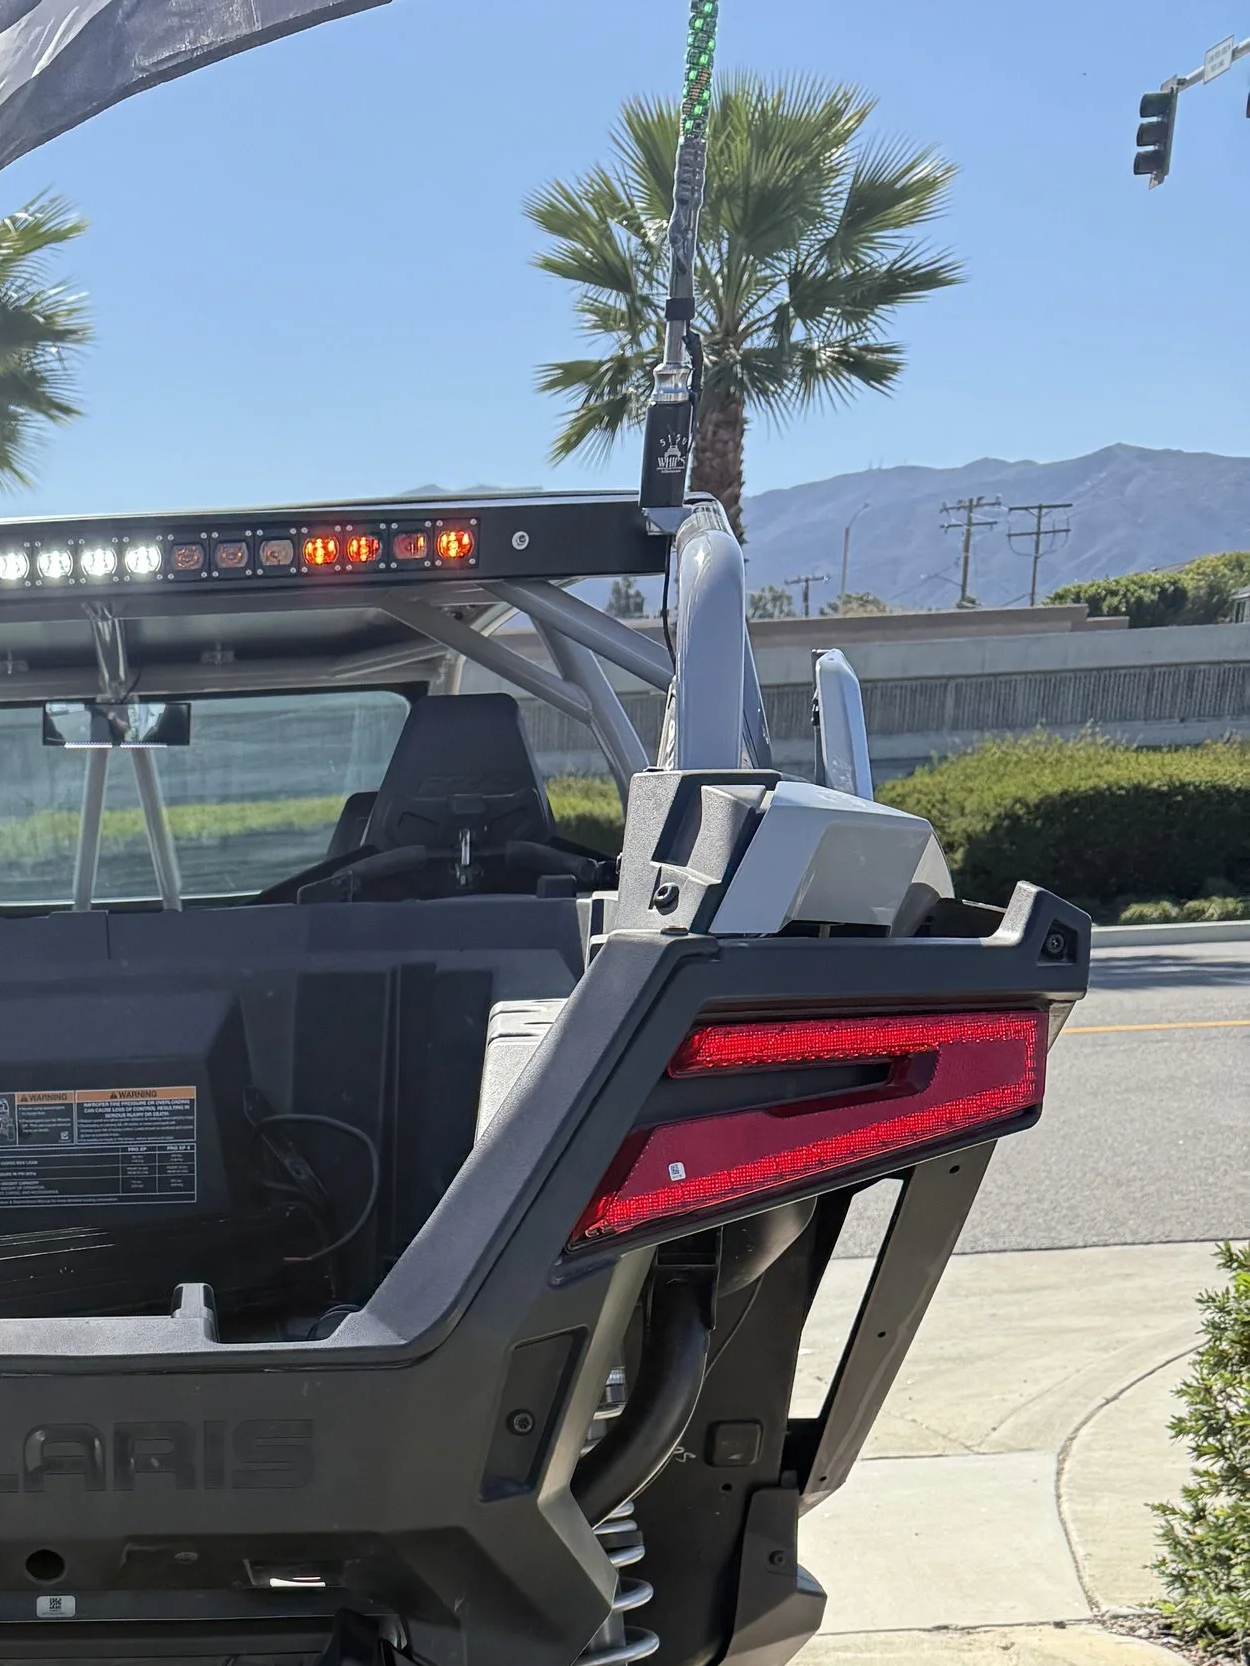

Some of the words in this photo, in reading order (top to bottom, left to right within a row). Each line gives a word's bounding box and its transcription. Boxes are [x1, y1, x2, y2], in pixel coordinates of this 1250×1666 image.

[659, 434, 688, 447] 5150
[29, 1093, 67, 1101] WARNING
[118, 1090, 157, 1099] WARNING
